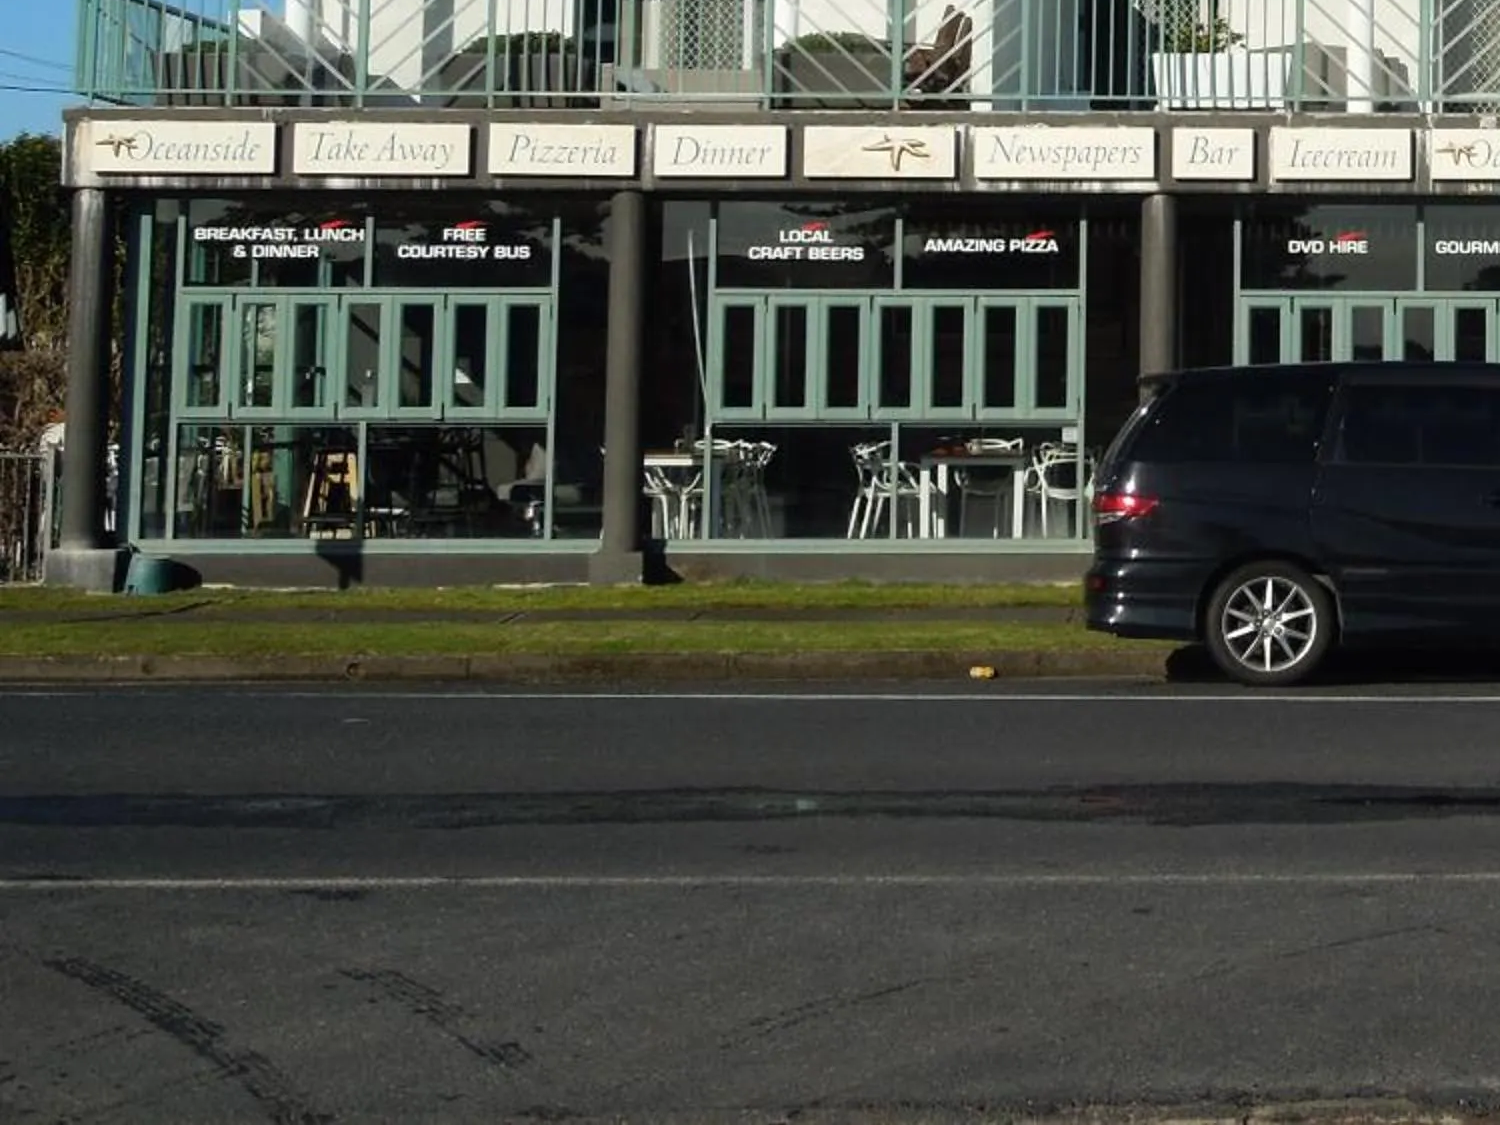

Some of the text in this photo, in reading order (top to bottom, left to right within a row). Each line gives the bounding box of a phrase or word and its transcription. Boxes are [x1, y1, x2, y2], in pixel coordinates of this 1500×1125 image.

[128, 131, 260, 161] Oceanside
[311, 131, 454, 170] Take Away
[509, 134, 617, 164] Pizzeria
[674, 136, 771, 165] Dinner
[990, 135, 1143, 172] Newspapers
[1190, 136, 1239, 164] Bar
[1289, 139, 1397, 168] Icecream
[194, 227, 365, 242] BREAKFAST, LUNCH
[443, 228, 486, 242] FREE
[779, 228, 833, 244] LOCAL
[233, 244, 319, 258] & DINNER
[398, 245, 530, 259] COURTESY BUS
[747, 246, 864, 260] CRAFT BEERS
[924, 238, 1058, 252] AMAZING PIZZA
[1288, 238, 1368, 254] DVD HIRE
